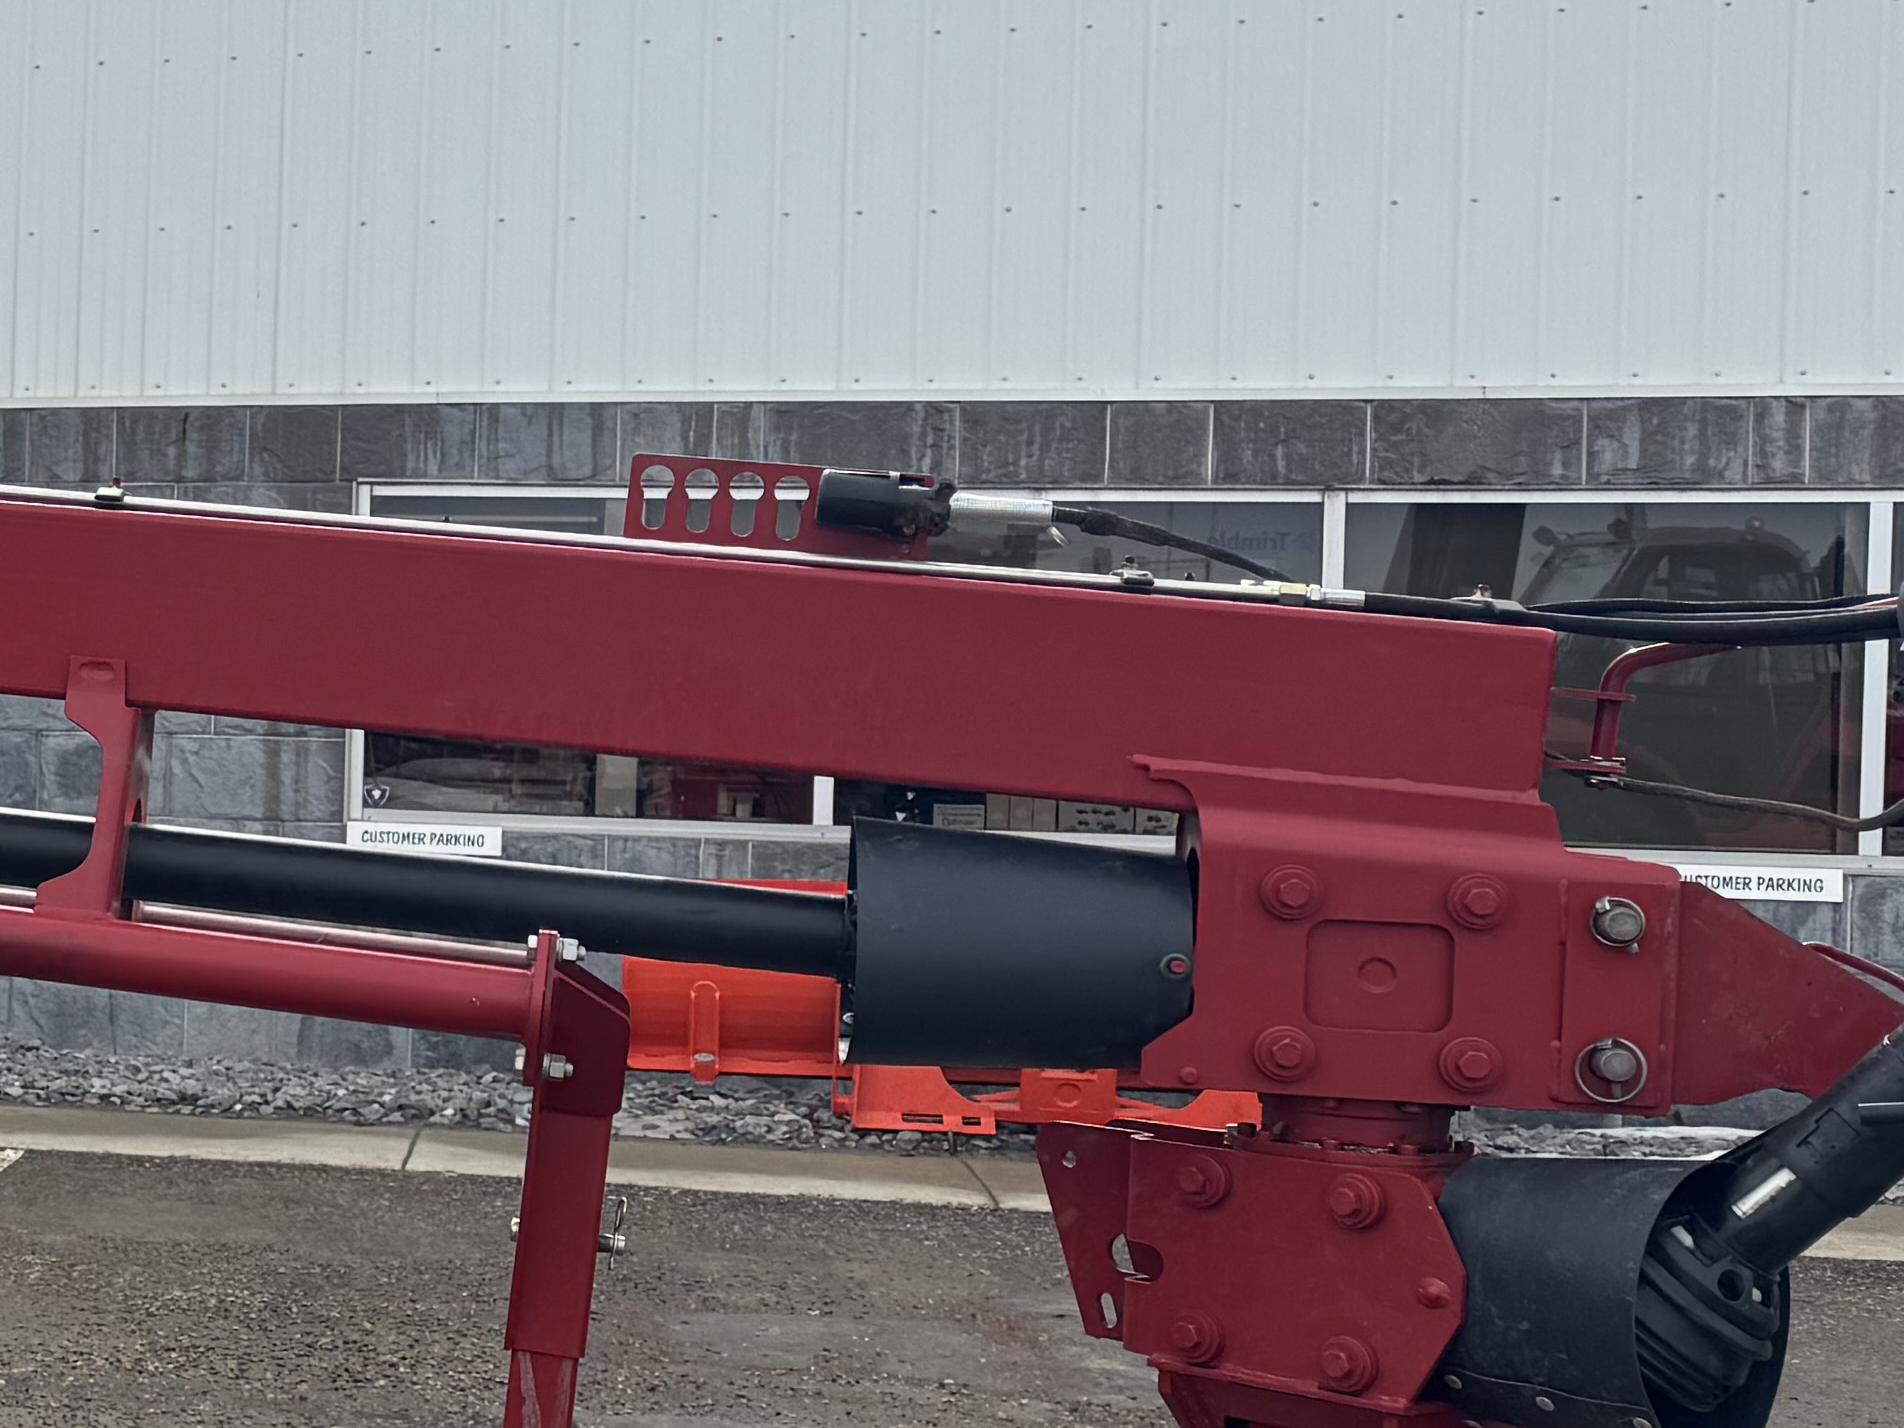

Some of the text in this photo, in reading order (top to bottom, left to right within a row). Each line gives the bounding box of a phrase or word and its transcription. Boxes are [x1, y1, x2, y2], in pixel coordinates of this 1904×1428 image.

[361, 830, 485, 848] CUSTOMER PARKING
[1757, 876, 1824, 893] PARKING
